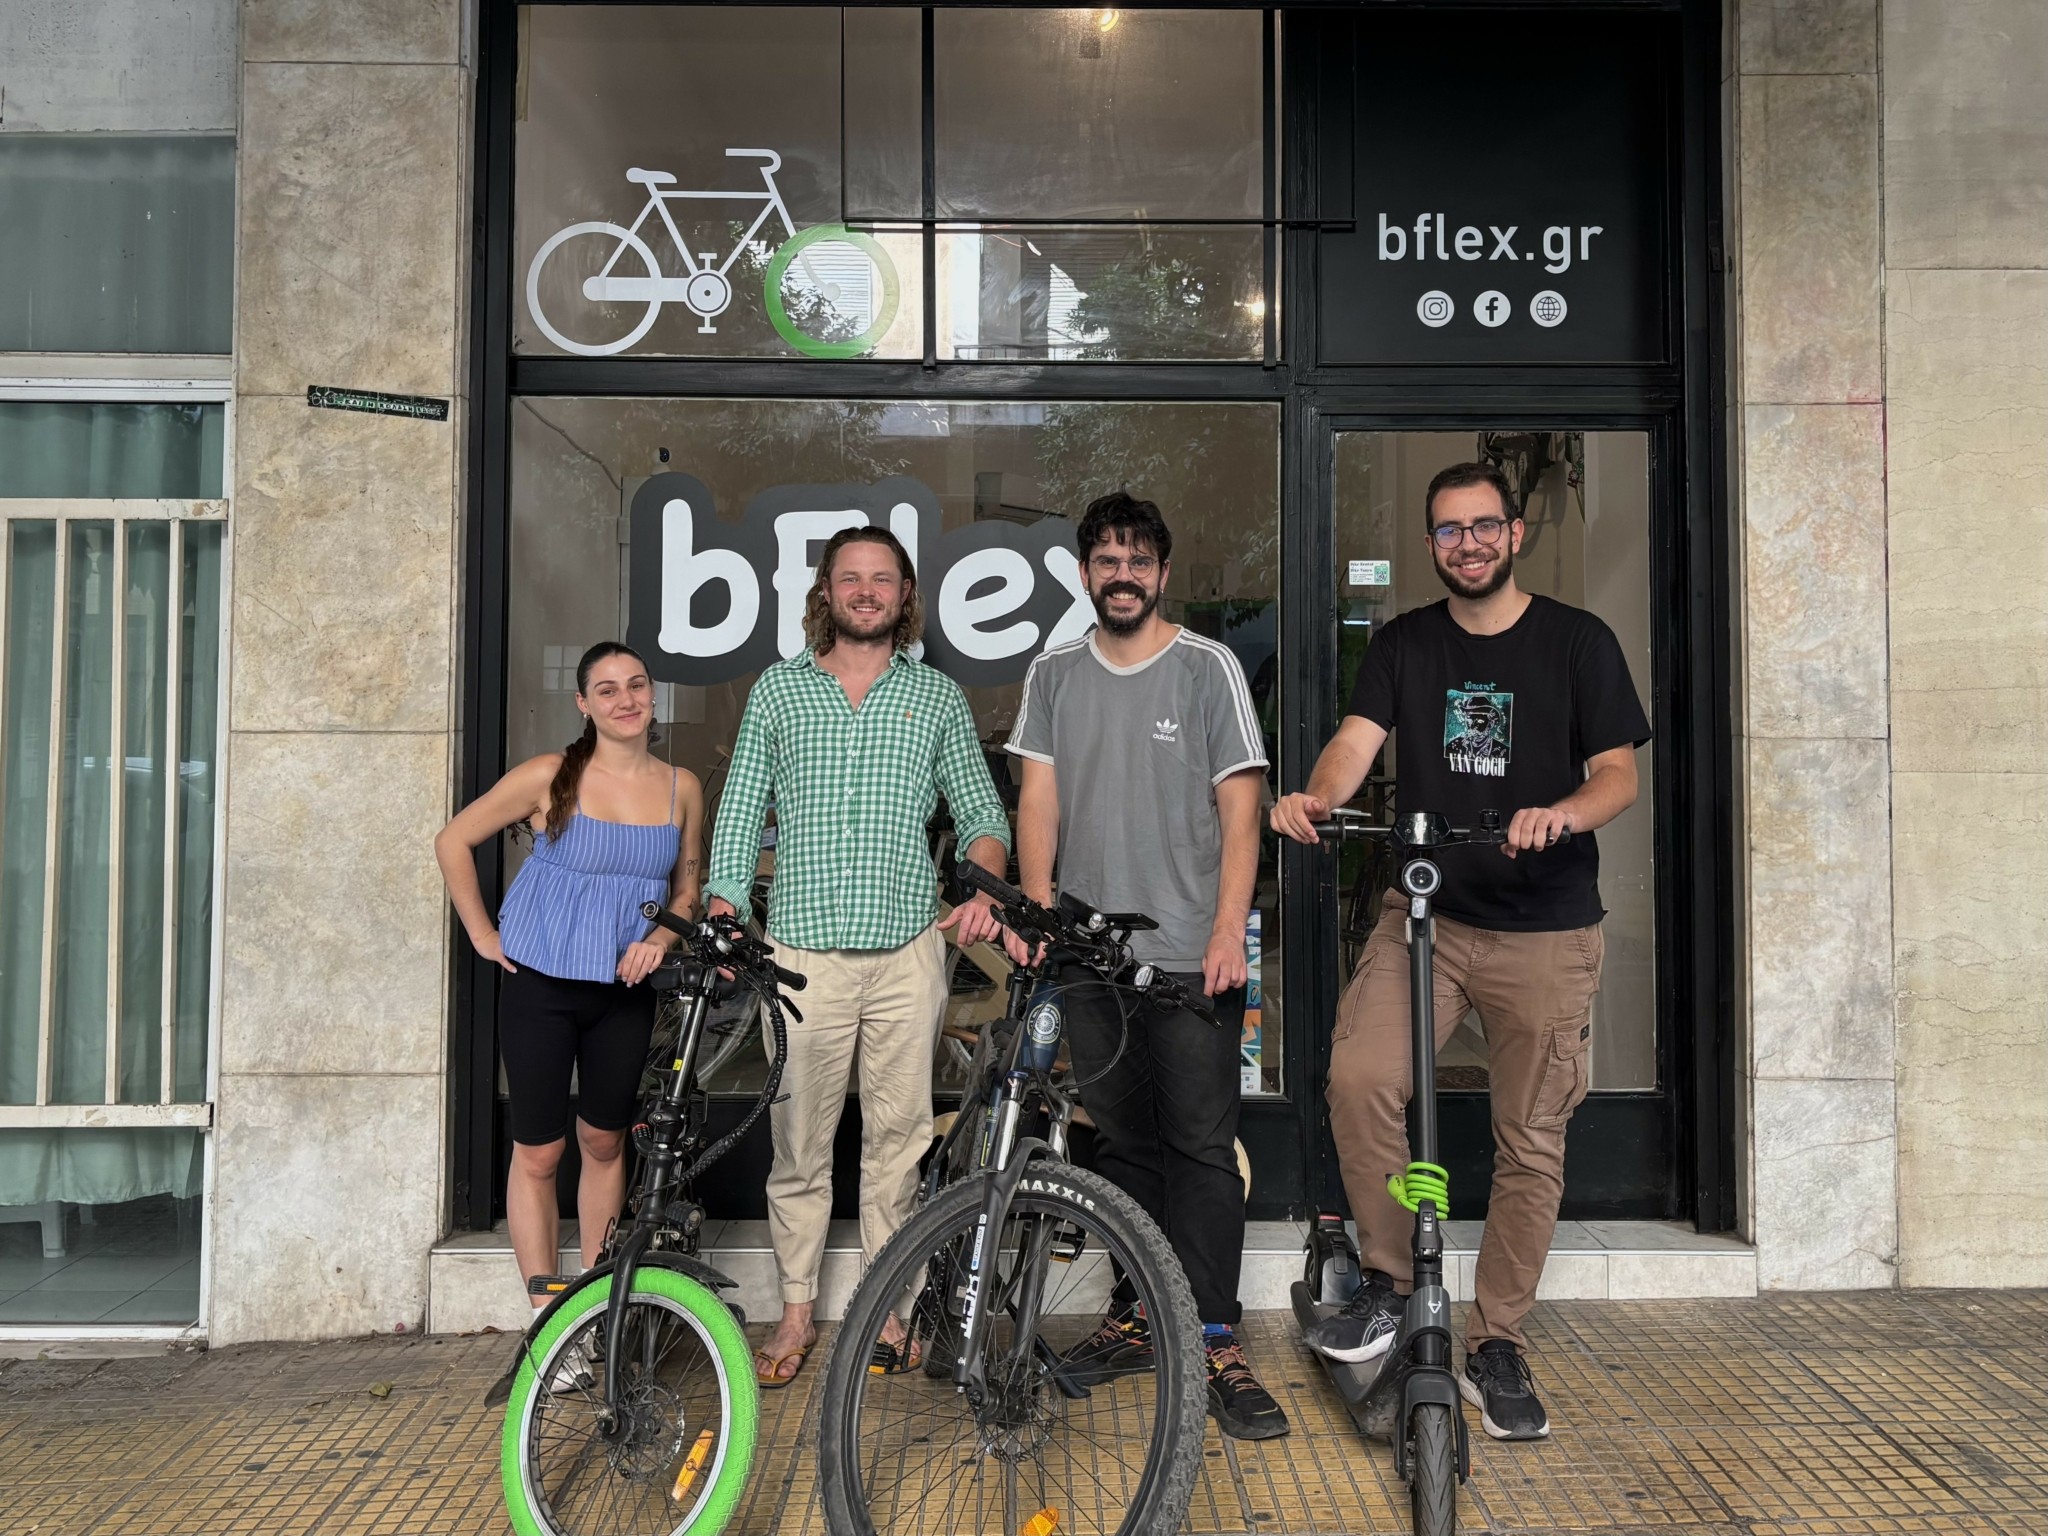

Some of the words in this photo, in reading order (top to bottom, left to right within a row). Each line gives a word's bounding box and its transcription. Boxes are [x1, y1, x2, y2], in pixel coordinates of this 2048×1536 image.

[1378, 213, 1603, 274] bflex.gr
[1464, 681, 1496, 691] Vincent
[1152, 733, 1176, 742] adidas
[1449, 753, 1471, 773] VAN
[1474, 756, 1506, 777] GOGH
[1017, 1179, 1095, 1211] MAXXIS
